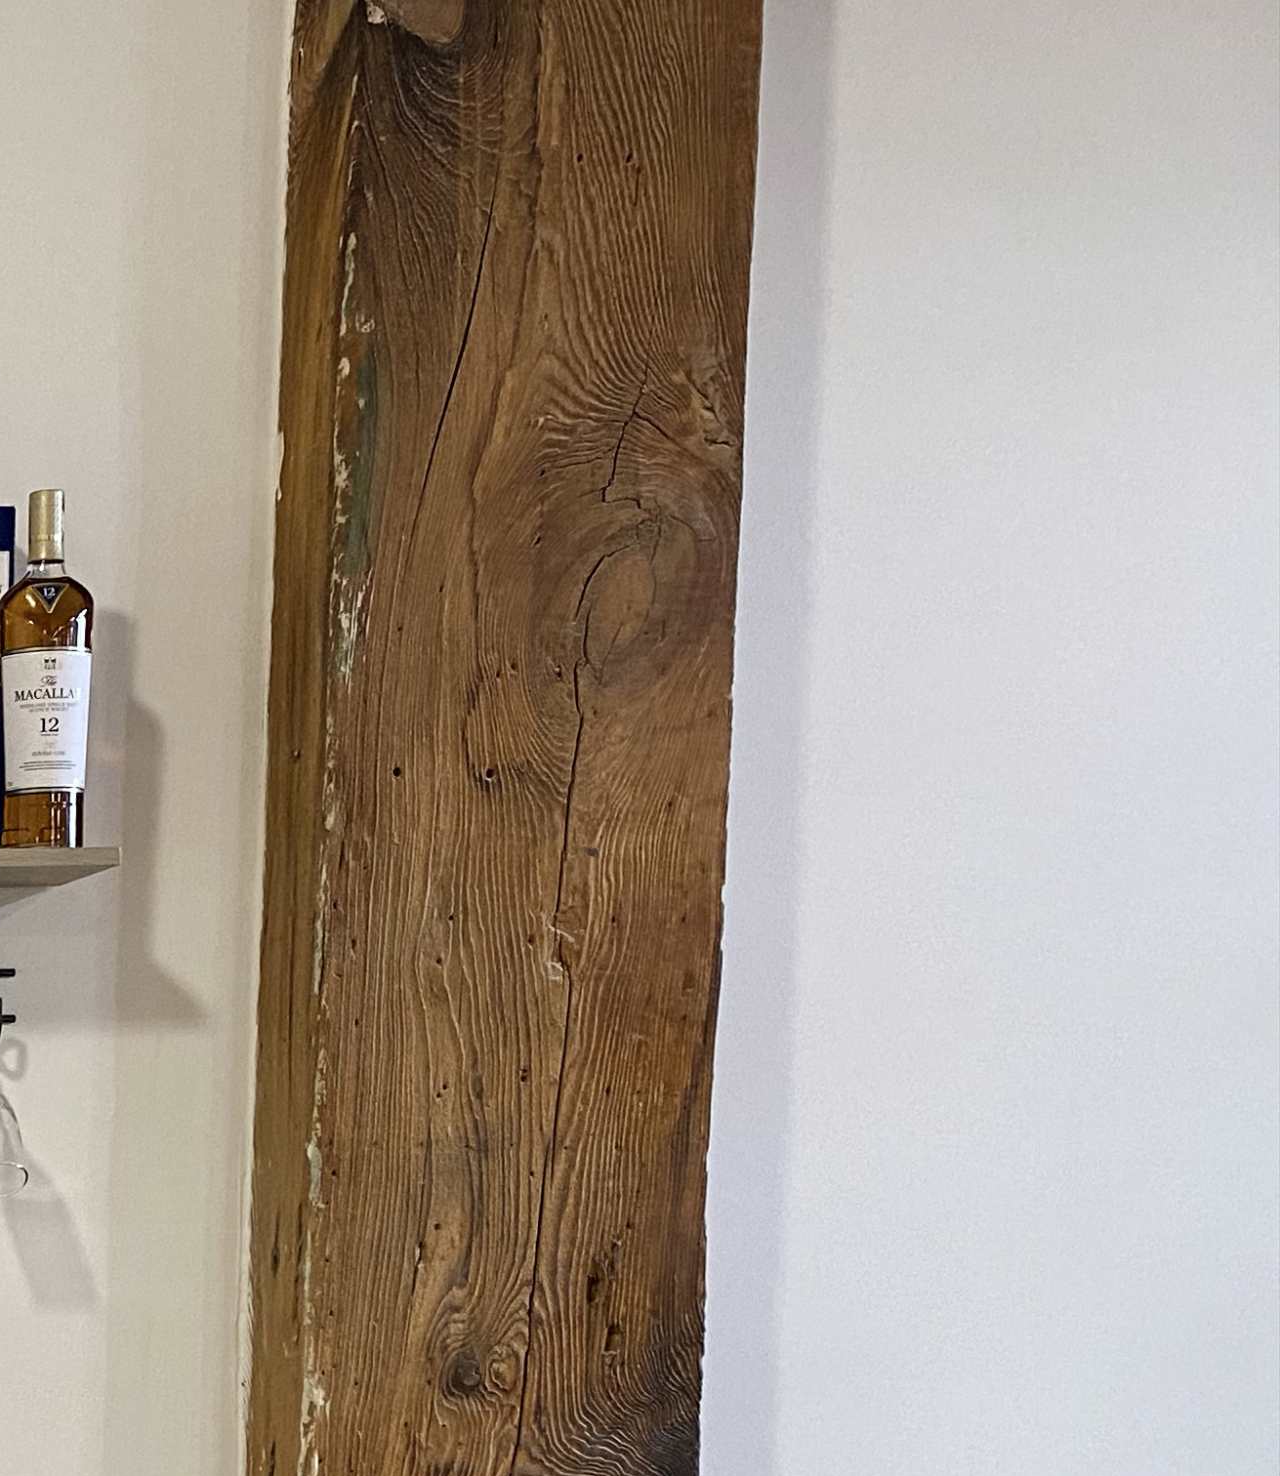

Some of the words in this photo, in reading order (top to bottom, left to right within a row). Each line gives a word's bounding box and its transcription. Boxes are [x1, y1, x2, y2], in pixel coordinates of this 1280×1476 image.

[42, 587, 56, 597] 12
[14, 688, 79, 702] MACALLA
[40, 717, 59, 733] 12
